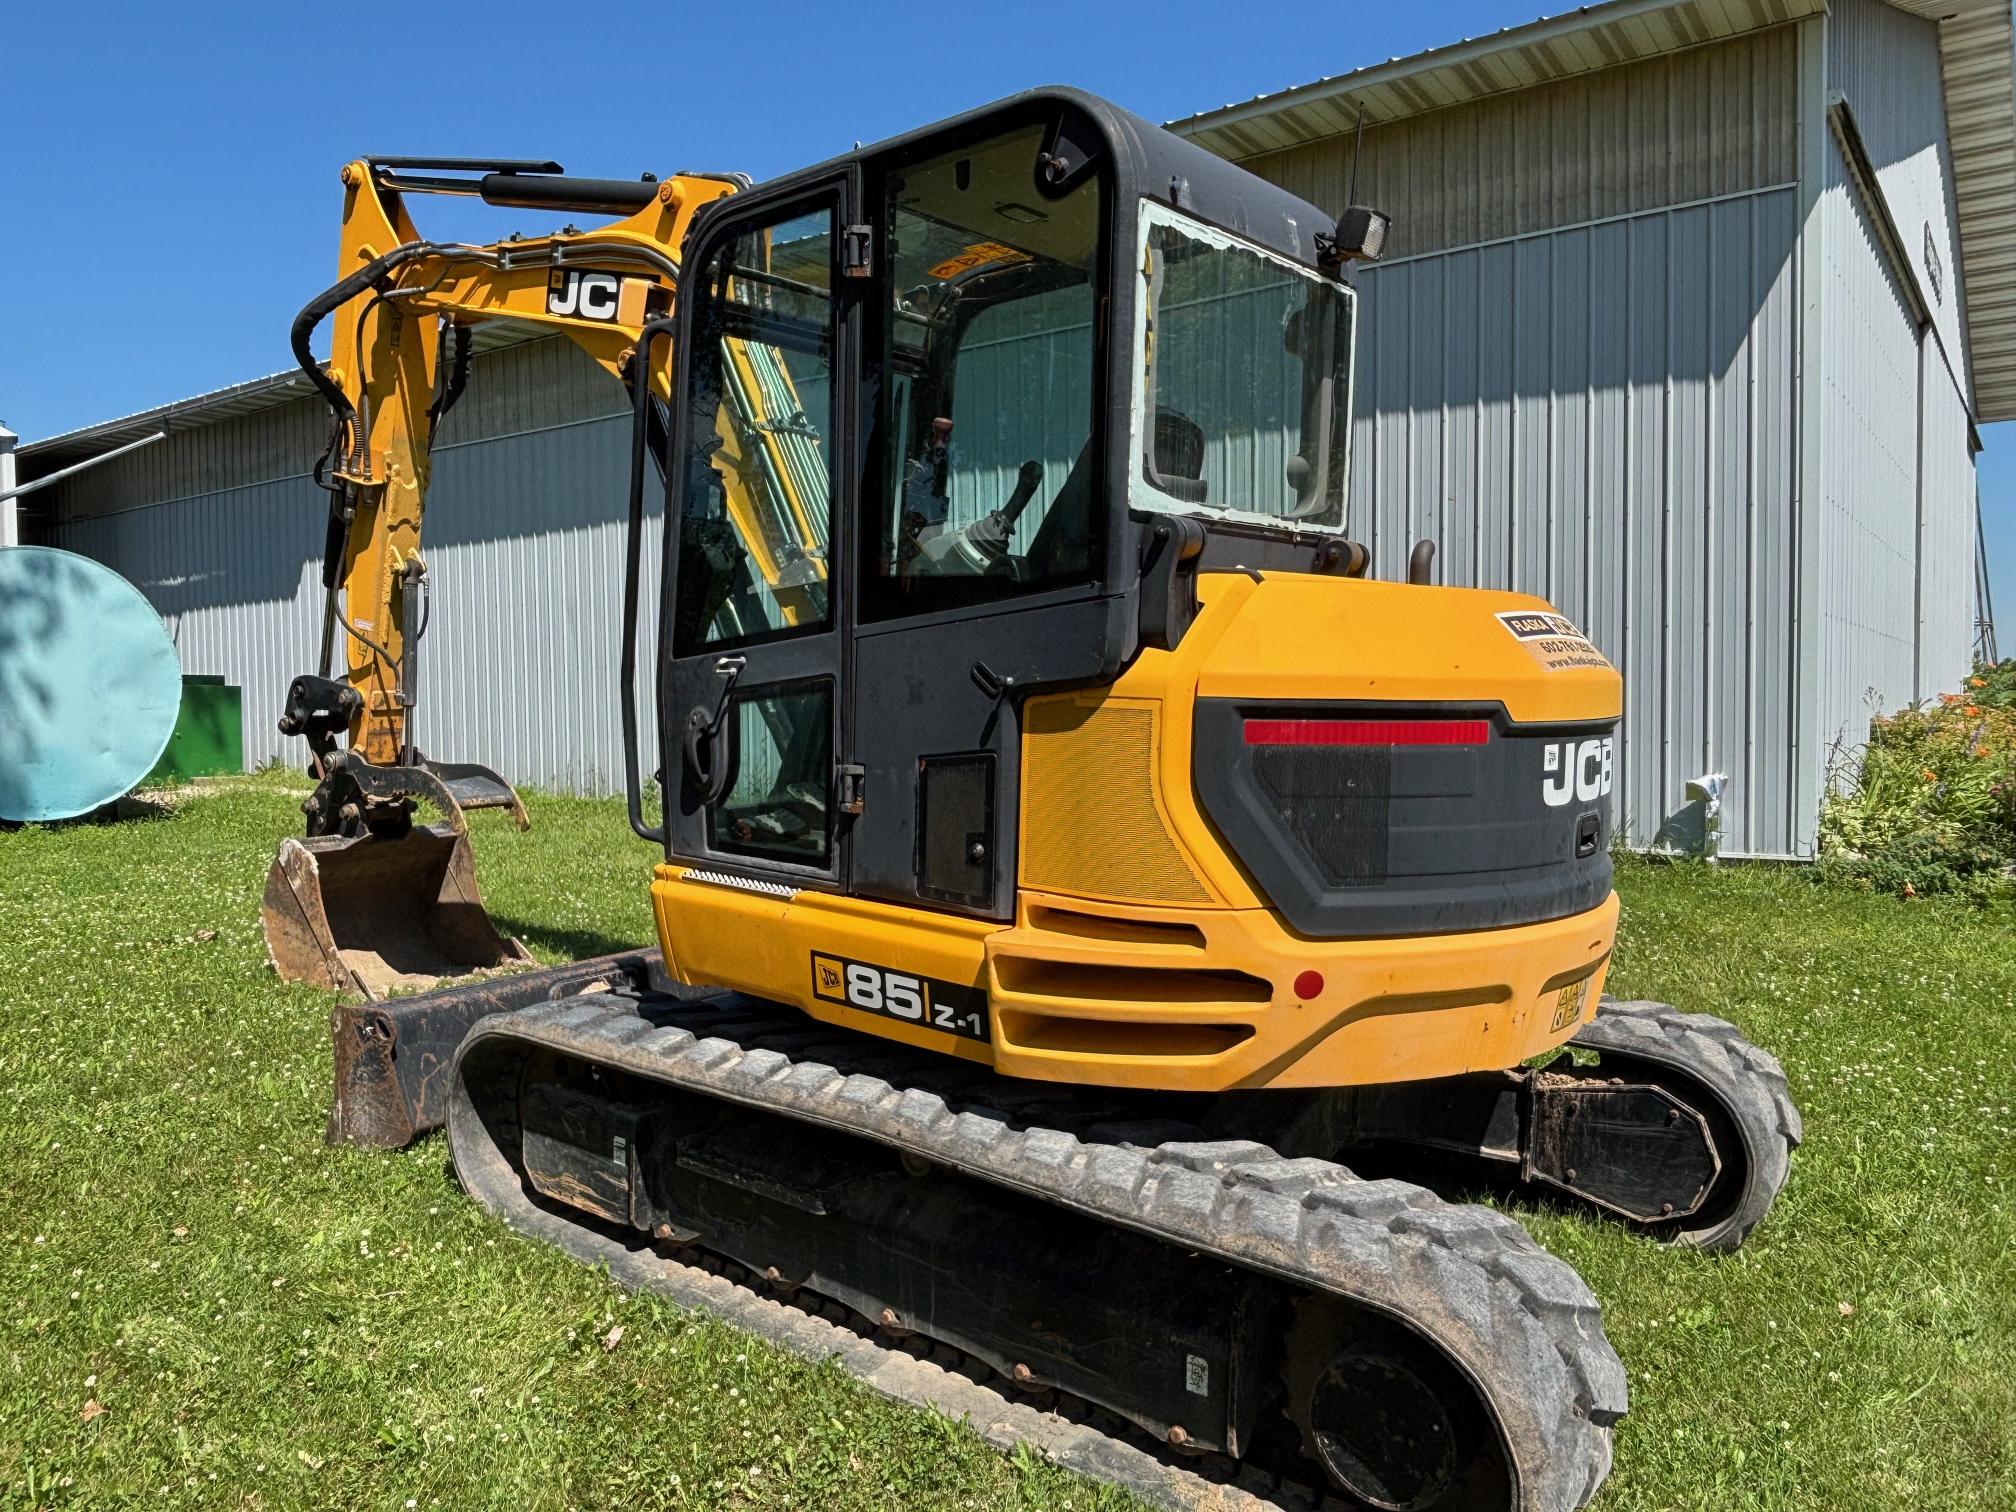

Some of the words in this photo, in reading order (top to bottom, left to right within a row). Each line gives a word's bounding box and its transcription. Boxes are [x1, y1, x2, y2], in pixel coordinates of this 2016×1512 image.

[549, 271, 618, 319] JC
[1511, 618, 1550, 632] FLASKA
[1543, 737, 1613, 807] JCB
[819, 964, 841, 988] JCB
[847, 964, 922, 1019] 85
